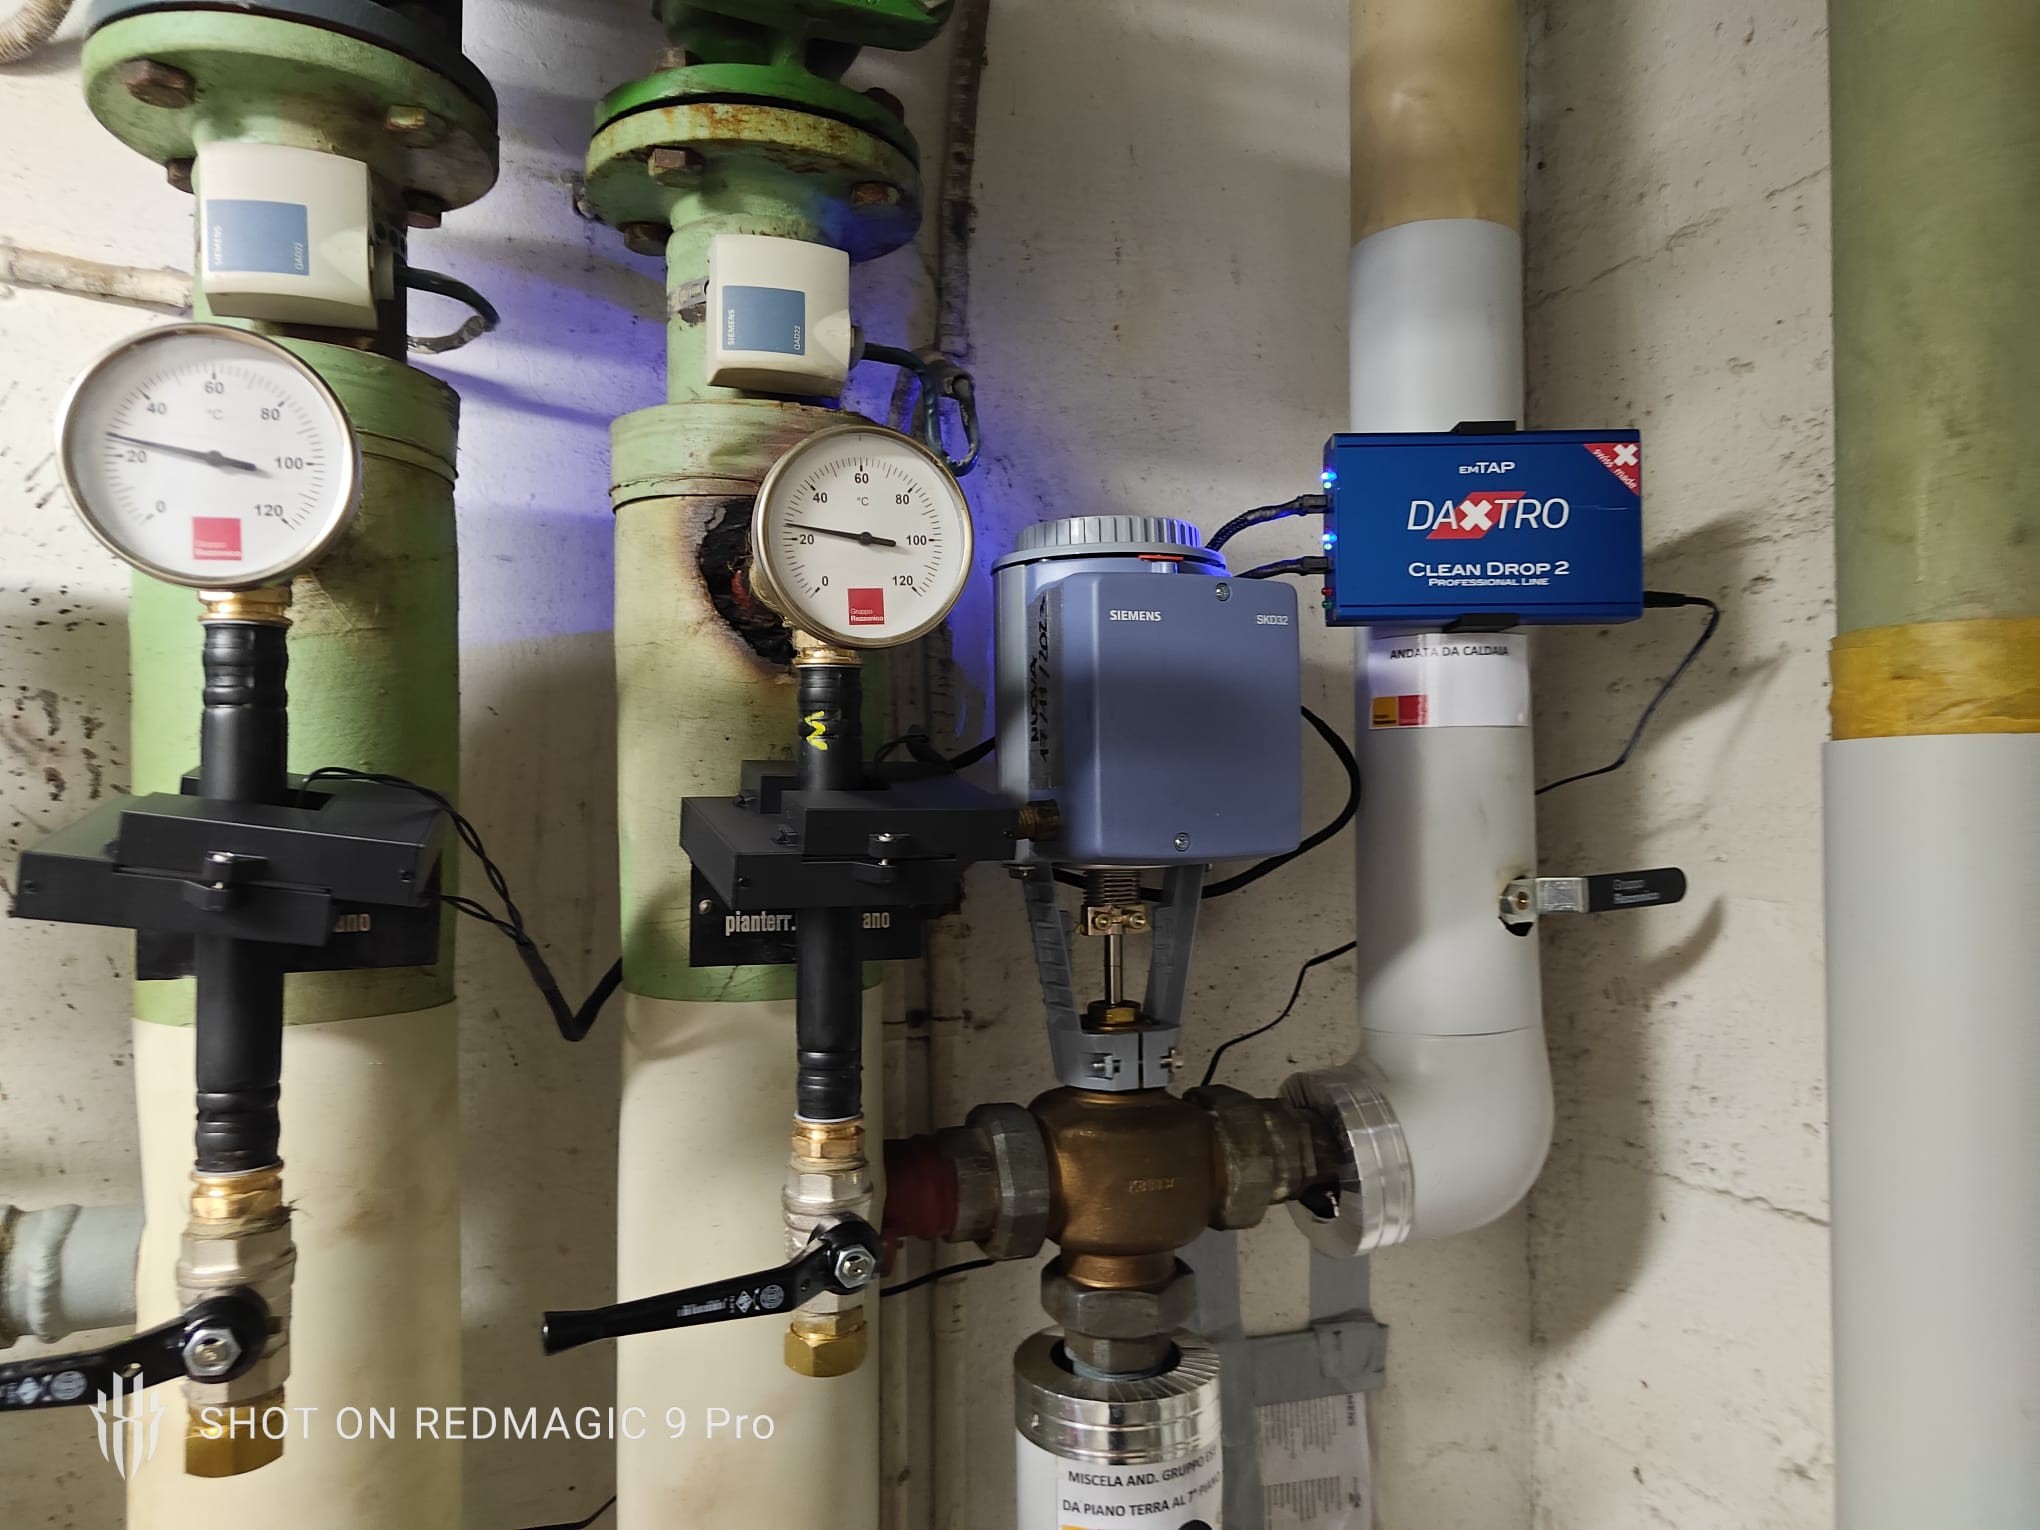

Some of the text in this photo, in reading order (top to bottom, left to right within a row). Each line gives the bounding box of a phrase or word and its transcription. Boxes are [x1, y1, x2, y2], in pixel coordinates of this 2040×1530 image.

[728, 308, 736, 345] SIEMENS
[205, 382, 224, 394] 60
[147, 402, 168, 415] 40
[260, 408, 281, 421] 80
[127, 451, 147, 463] 20
[274, 457, 303, 470] 100
[854, 473, 869, 484] 60
[812, 493, 828, 504] 40
[895, 493, 910, 505] 80
[156, 501, 166, 514] 0
[254, 505, 283, 518] 120
[799, 534, 815, 546] 20
[905, 534, 927, 546] 100
[1408, 561, 1570, 577] CLEAN DROP 2
[821, 575, 829, 587] 0
[892, 575, 914, 587] 120
[1521, 577, 1550, 586] LINE
[1109, 609, 1289, 625] SIEMENS SKD32
[1390, 646, 1510, 659] ANDATA DA CALDAIA
[725, 911, 796, 936] pianterr.
[1068, 1471, 1123, 1487] MISCELA
[1126, 1473, 1159, 1487] AND.
[1162, 1455, 1204, 1481] GRUPPO
[1062, 1500, 1080, 1513] DA
[1084, 1503, 1125, 1516] PIANO
[1129, 1500, 1169, 1516] TERRA
[1172, 1495, 1187, 1509] AL
